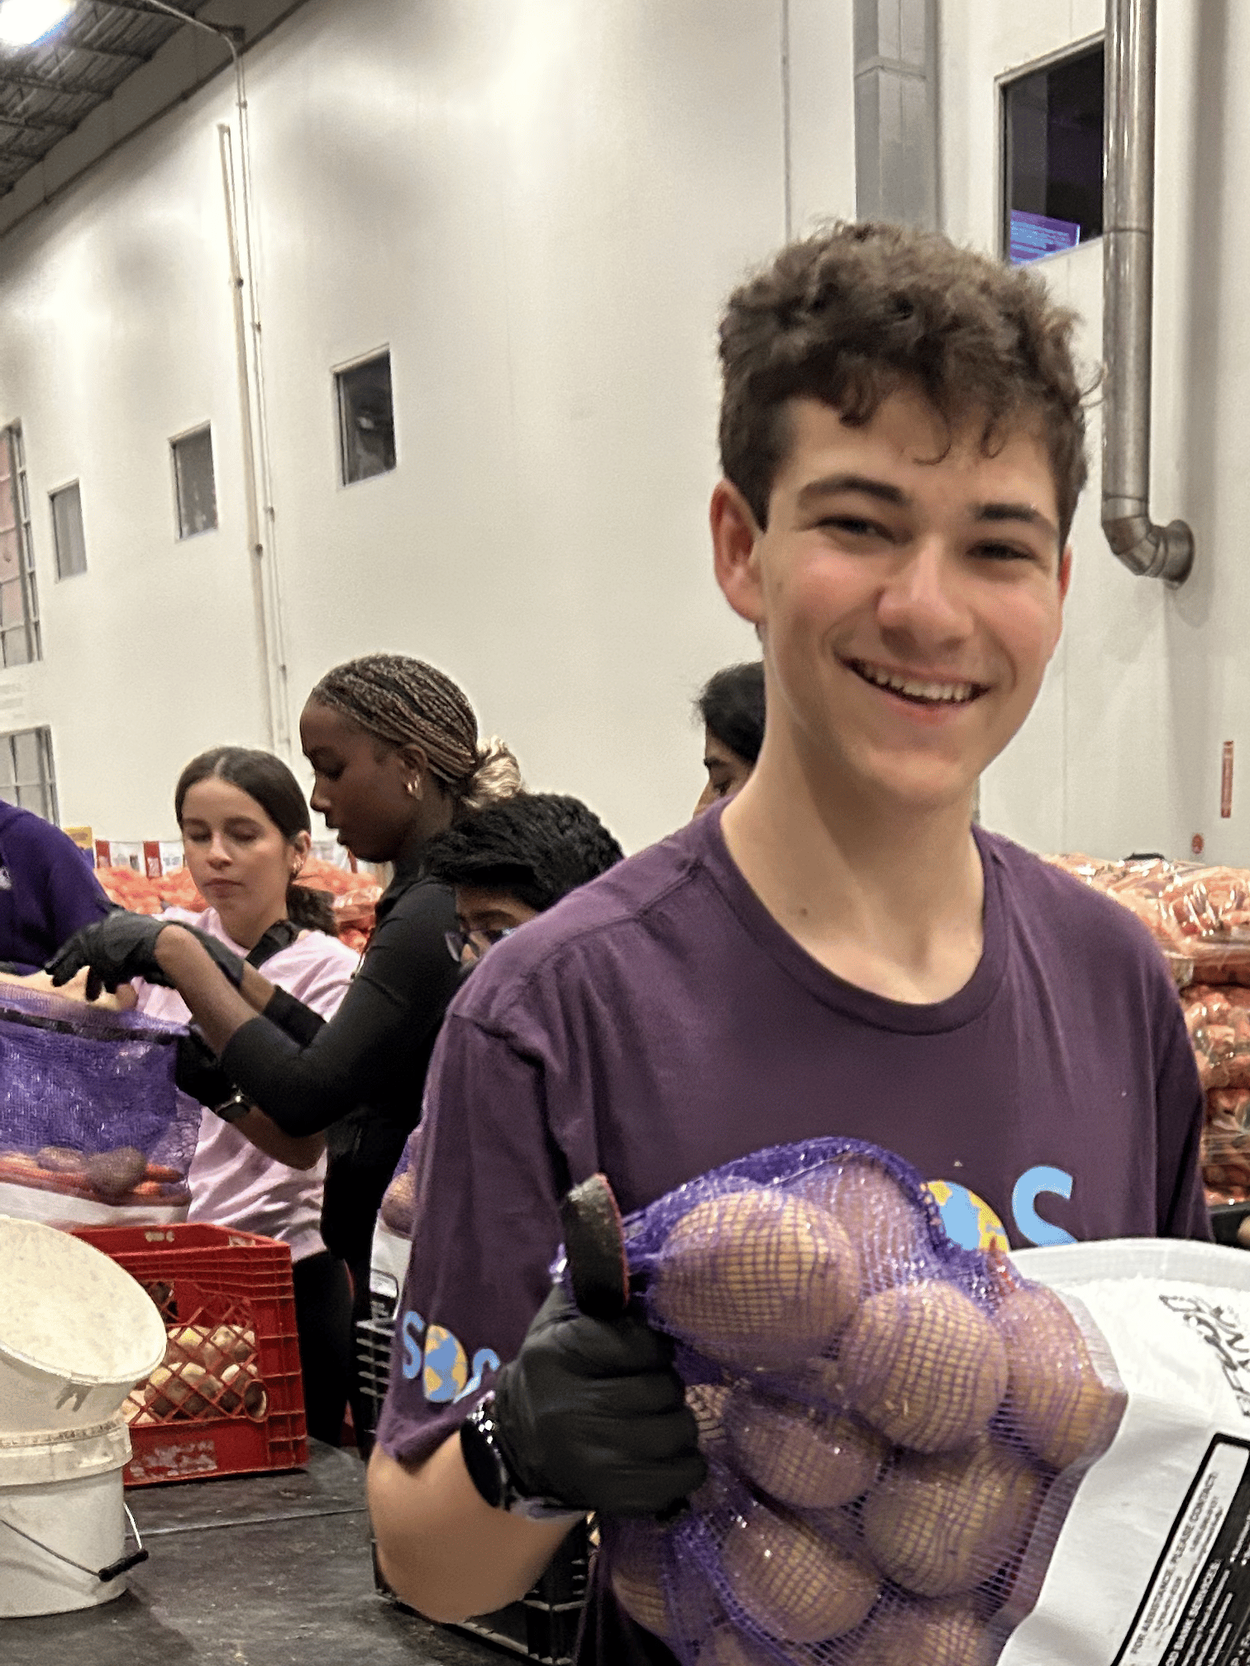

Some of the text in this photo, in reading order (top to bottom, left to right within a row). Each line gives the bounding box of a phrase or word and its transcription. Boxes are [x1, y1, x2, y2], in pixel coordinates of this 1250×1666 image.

[1130, 1631, 1147, 1655] FOR
[1170, 1523, 1195, 1565] PLEASE
[1174, 1616, 1196, 1651] BANK
